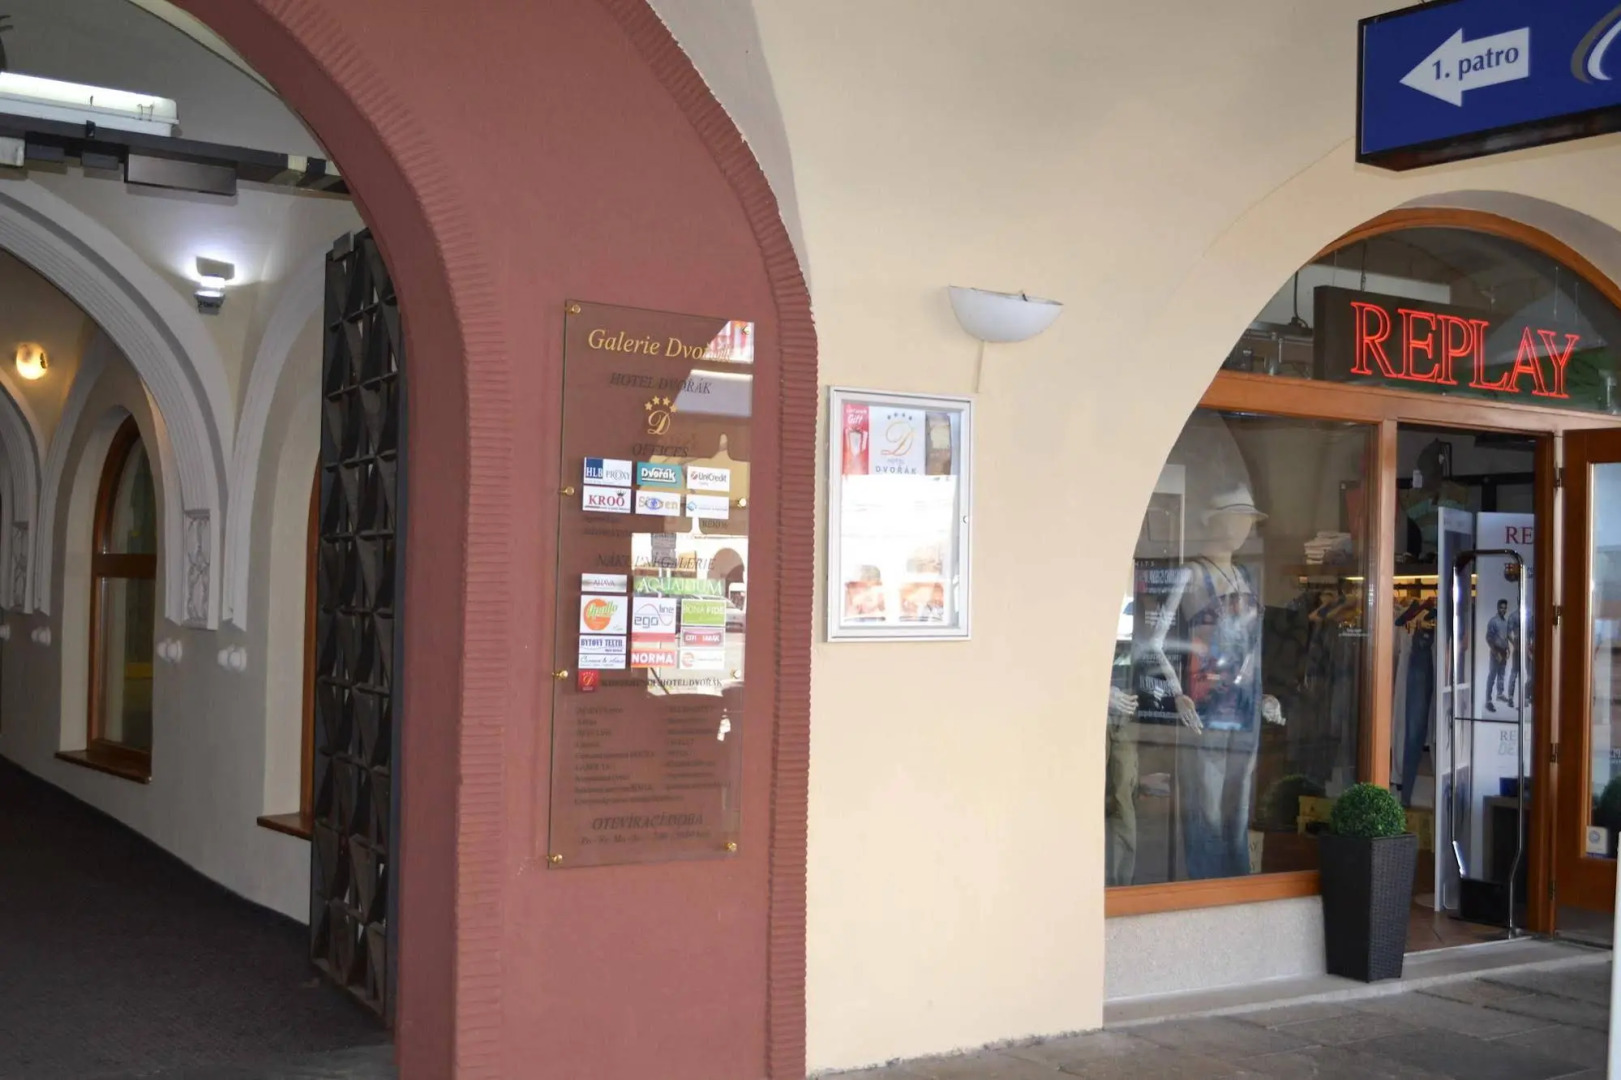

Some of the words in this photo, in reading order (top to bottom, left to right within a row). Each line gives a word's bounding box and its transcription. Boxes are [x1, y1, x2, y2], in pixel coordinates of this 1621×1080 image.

[1432, 60, 1451, 81] 1.
[1457, 43, 1520, 81] patro
[588, 328, 661, 358] Galerie
[664, 337, 731, 363] Dvoř
[1350, 300, 1581, 399] REPLAY
[610, 371, 655, 391] HOTEL
[658, 376, 713, 395] DVOŘÁK
[632, 442, 690, 458] OFFICES
[585, 467, 604, 479] HLB
[640, 466, 677, 482] Dvořák
[698, 472, 728, 483] UniCredit
[875, 464, 918, 475] DVOŘÁK
[633, 615, 660, 630] ego
[631, 651, 674, 665] NORMA
